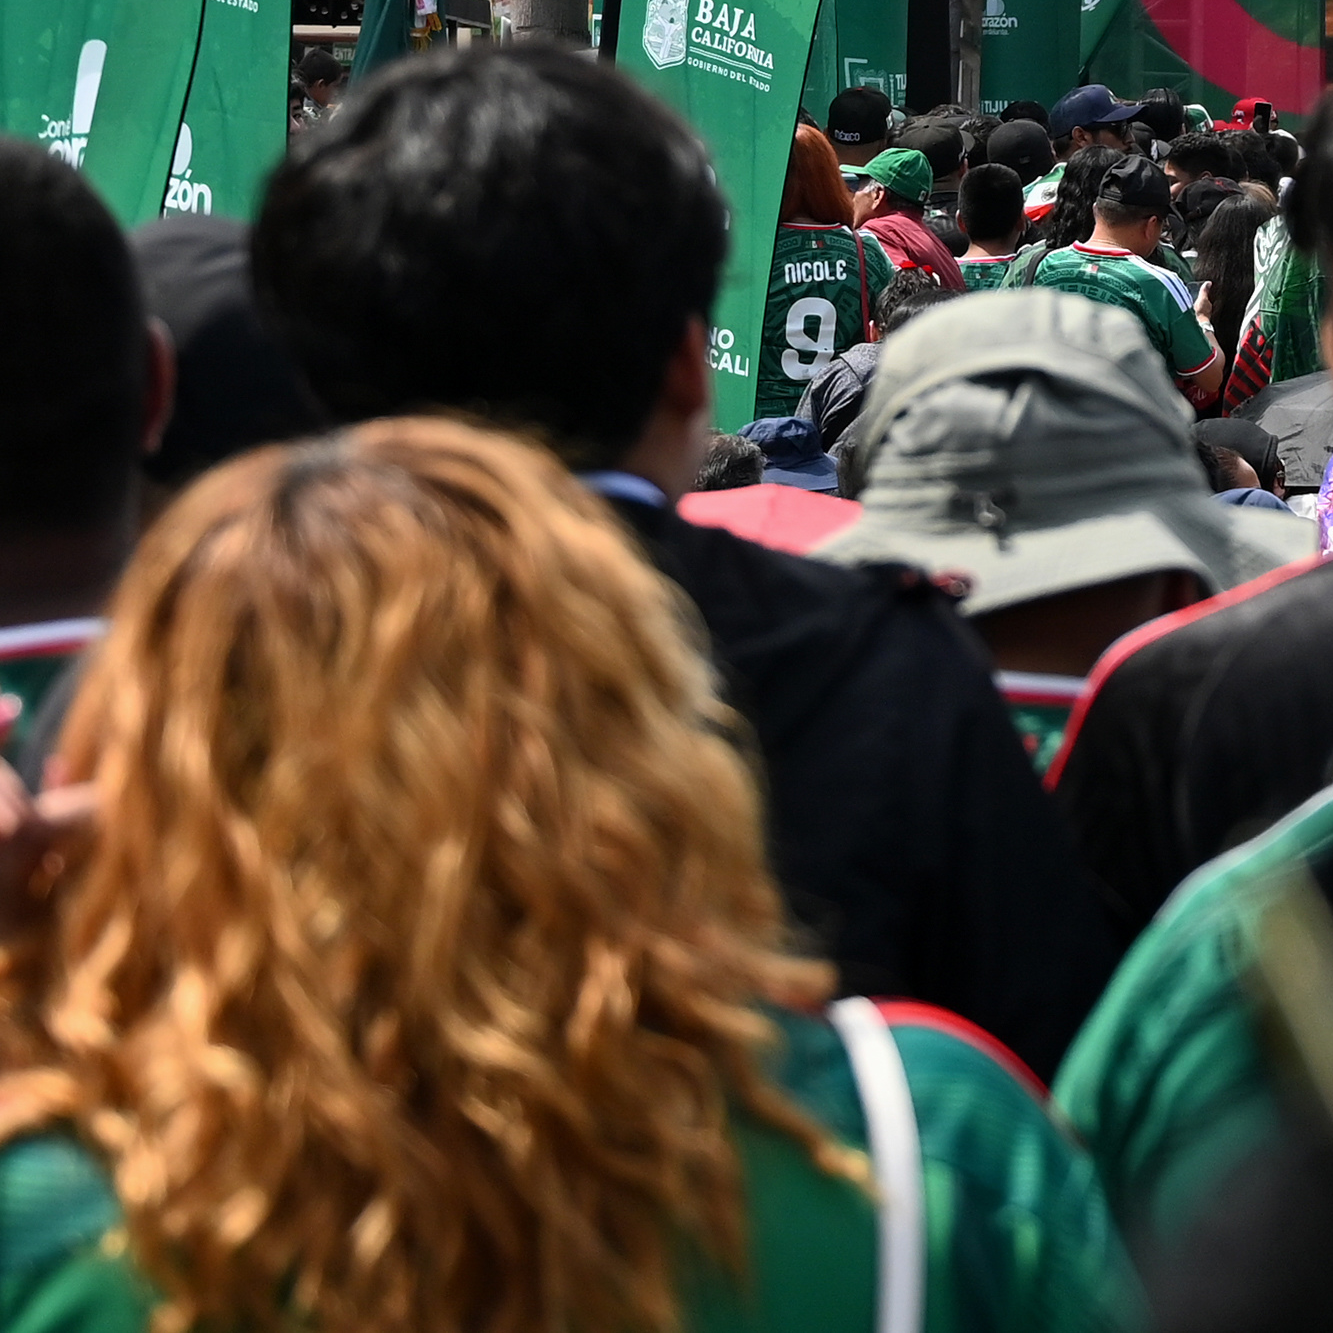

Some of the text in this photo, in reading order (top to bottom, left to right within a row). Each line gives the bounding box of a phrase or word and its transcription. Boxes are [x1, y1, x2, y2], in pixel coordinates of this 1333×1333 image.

[691, 27, 774, 70] CALIFORNIA
[687, 56, 728, 77] GOBIERNO
[729, 70, 747, 83] DEL
[785, 260, 847, 284] NICOLE
[781, 296, 837, 381] 9
